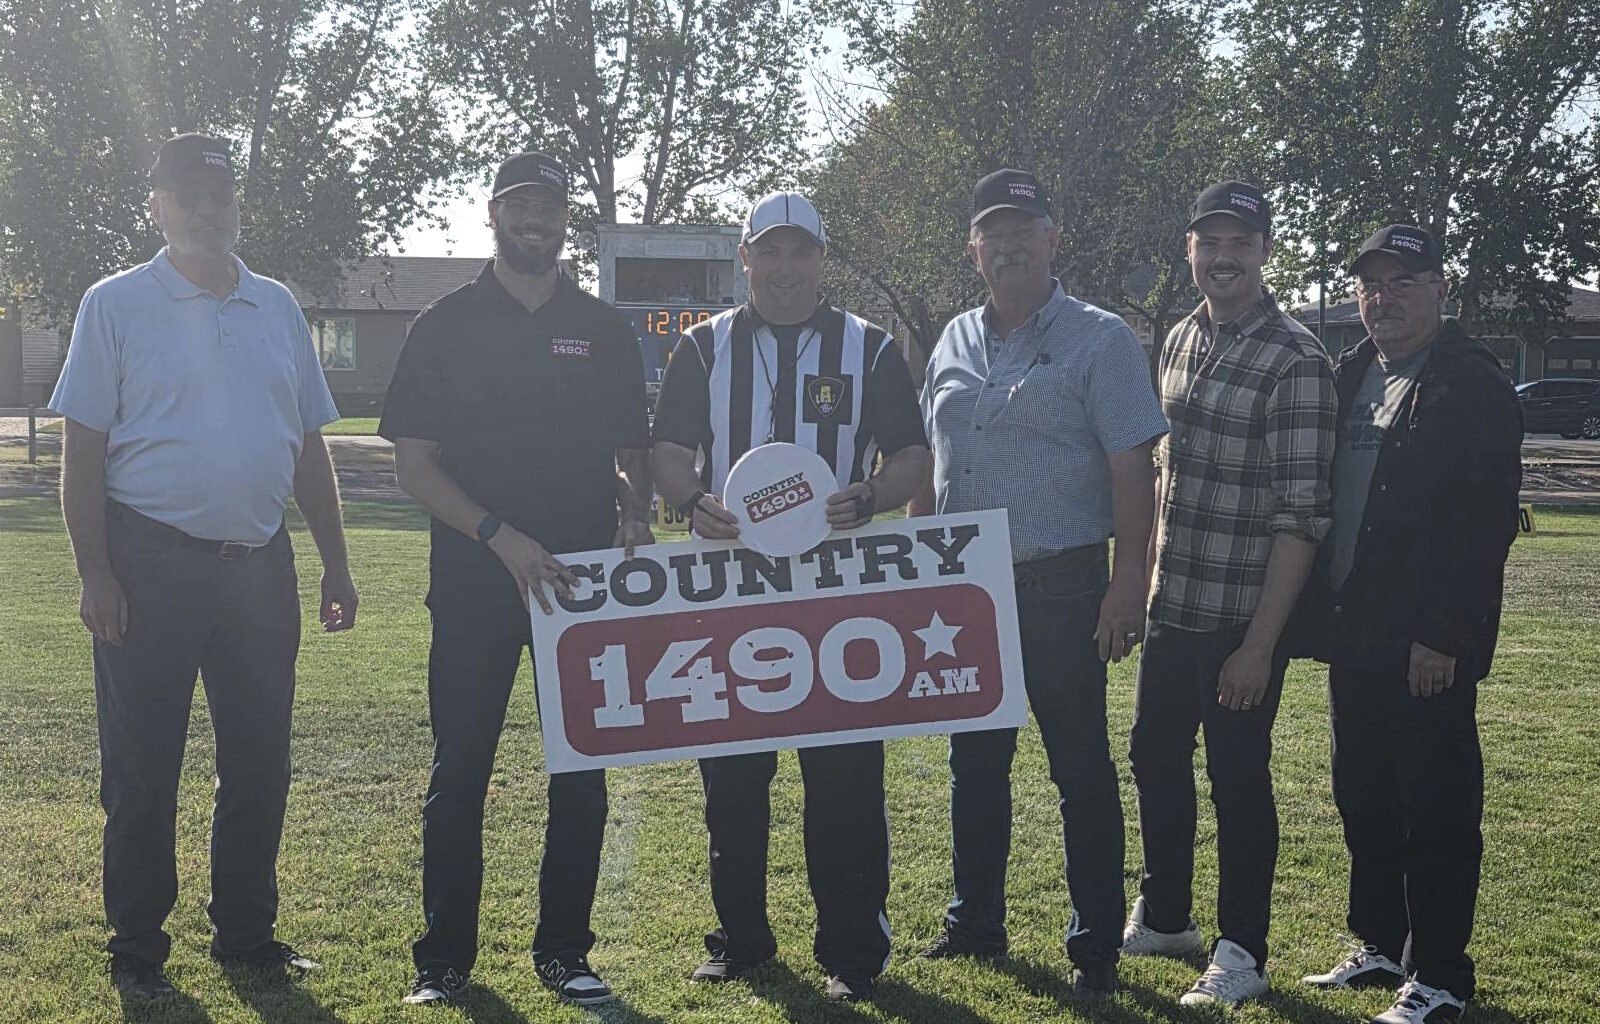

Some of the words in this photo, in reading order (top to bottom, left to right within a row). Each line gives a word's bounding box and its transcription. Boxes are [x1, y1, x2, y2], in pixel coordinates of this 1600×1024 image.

[553, 338, 590, 346] COUNTRY
[553, 345, 583, 354] 1490
[743, 472, 804, 504] COUNTRY
[751, 490, 799, 520] 1490
[555, 523, 980, 613] COUNTRY
[588, 616, 906, 729] 1490
[908, 666, 980, 699] AM
